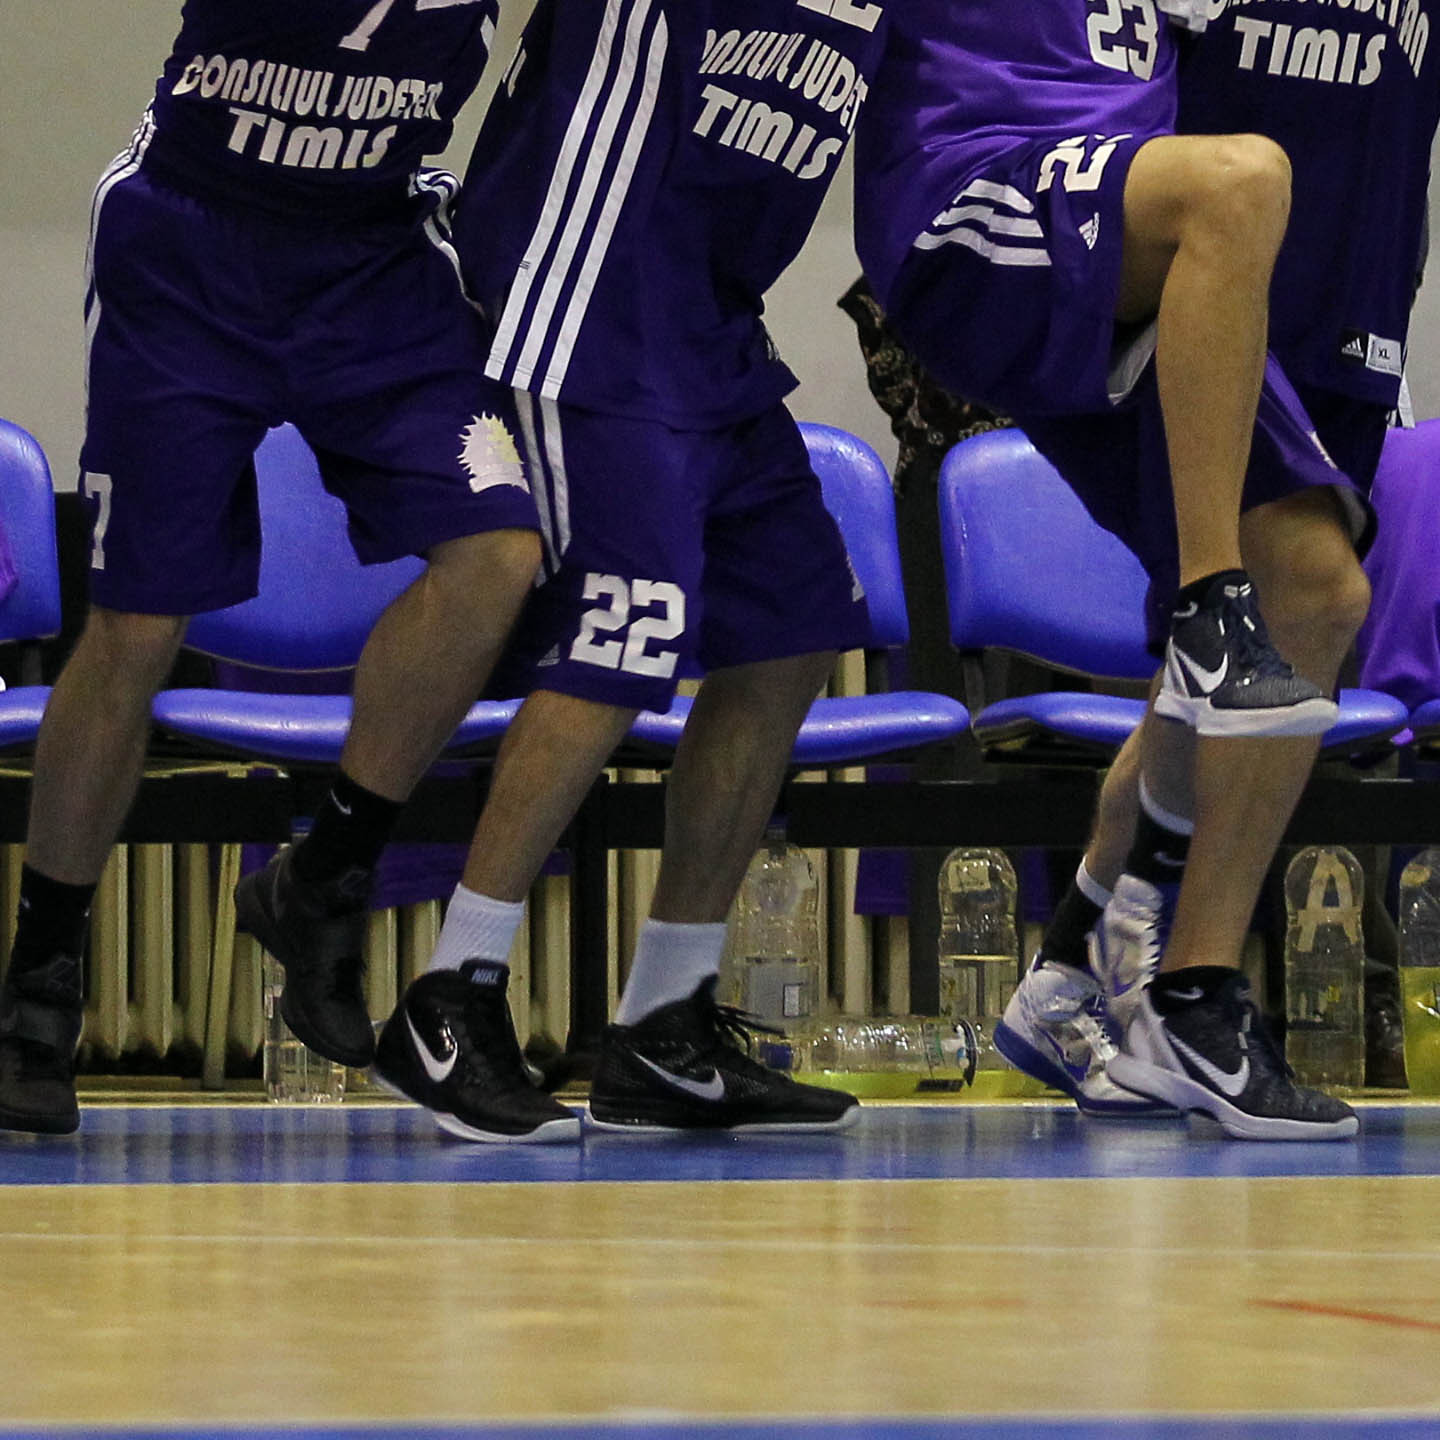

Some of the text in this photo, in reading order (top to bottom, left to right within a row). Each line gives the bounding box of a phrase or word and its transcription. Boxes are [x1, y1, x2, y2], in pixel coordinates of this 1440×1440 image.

[171, 54, 334, 118] CONSILIUL
[1233, 15, 1386, 86] TIMIS
[227, 106, 398, 170] TIMIS
[692, 83, 842, 180] TIMIS
[1378, 348, 1391, 360] XL
[85, 472, 113, 570] 7
[569, 572, 686, 679] 22
